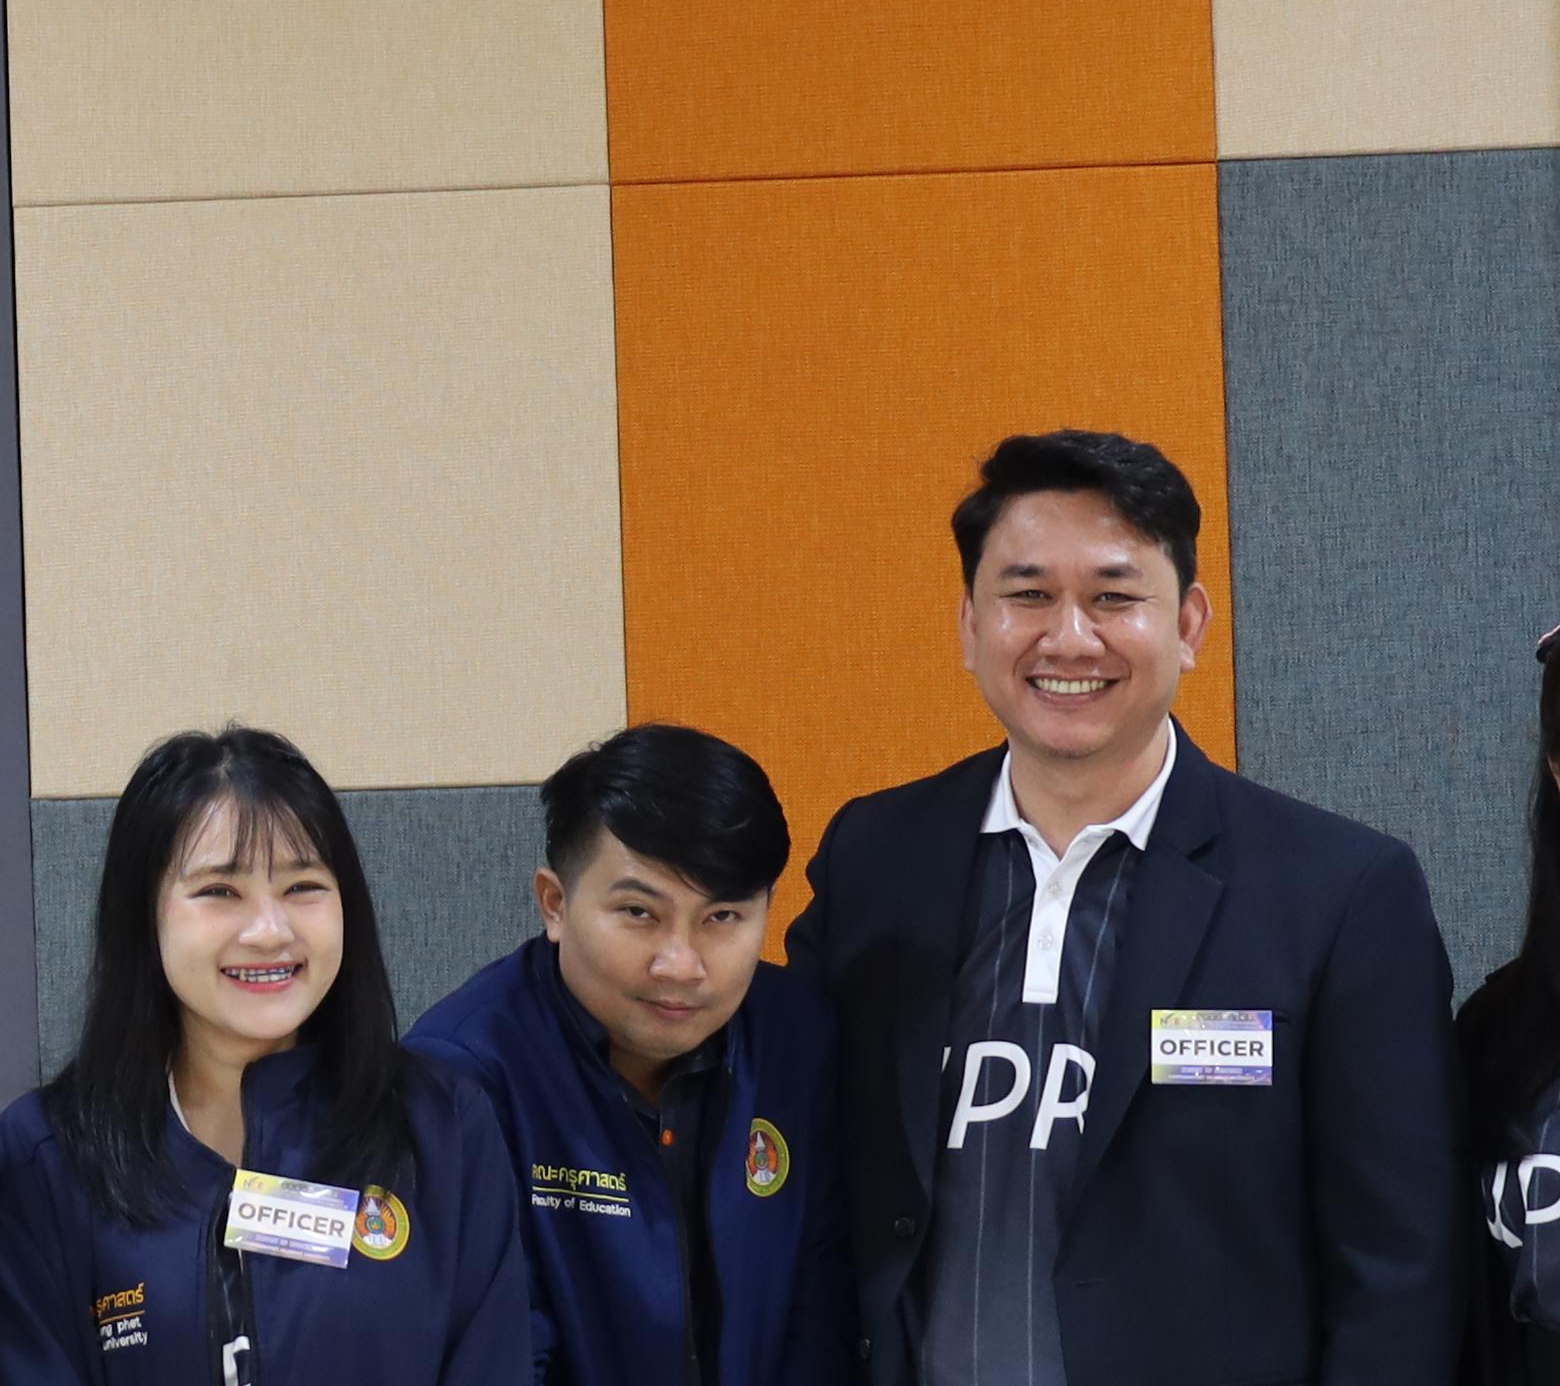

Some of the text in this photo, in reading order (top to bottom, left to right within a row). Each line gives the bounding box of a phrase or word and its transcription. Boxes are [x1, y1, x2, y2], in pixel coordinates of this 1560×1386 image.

[1160, 1039, 1264, 1056] OFFICER
[564, 1197, 575, 1208] of
[580, 1200, 631, 1217] Education
[238, 1202, 346, 1238] OFFICER
